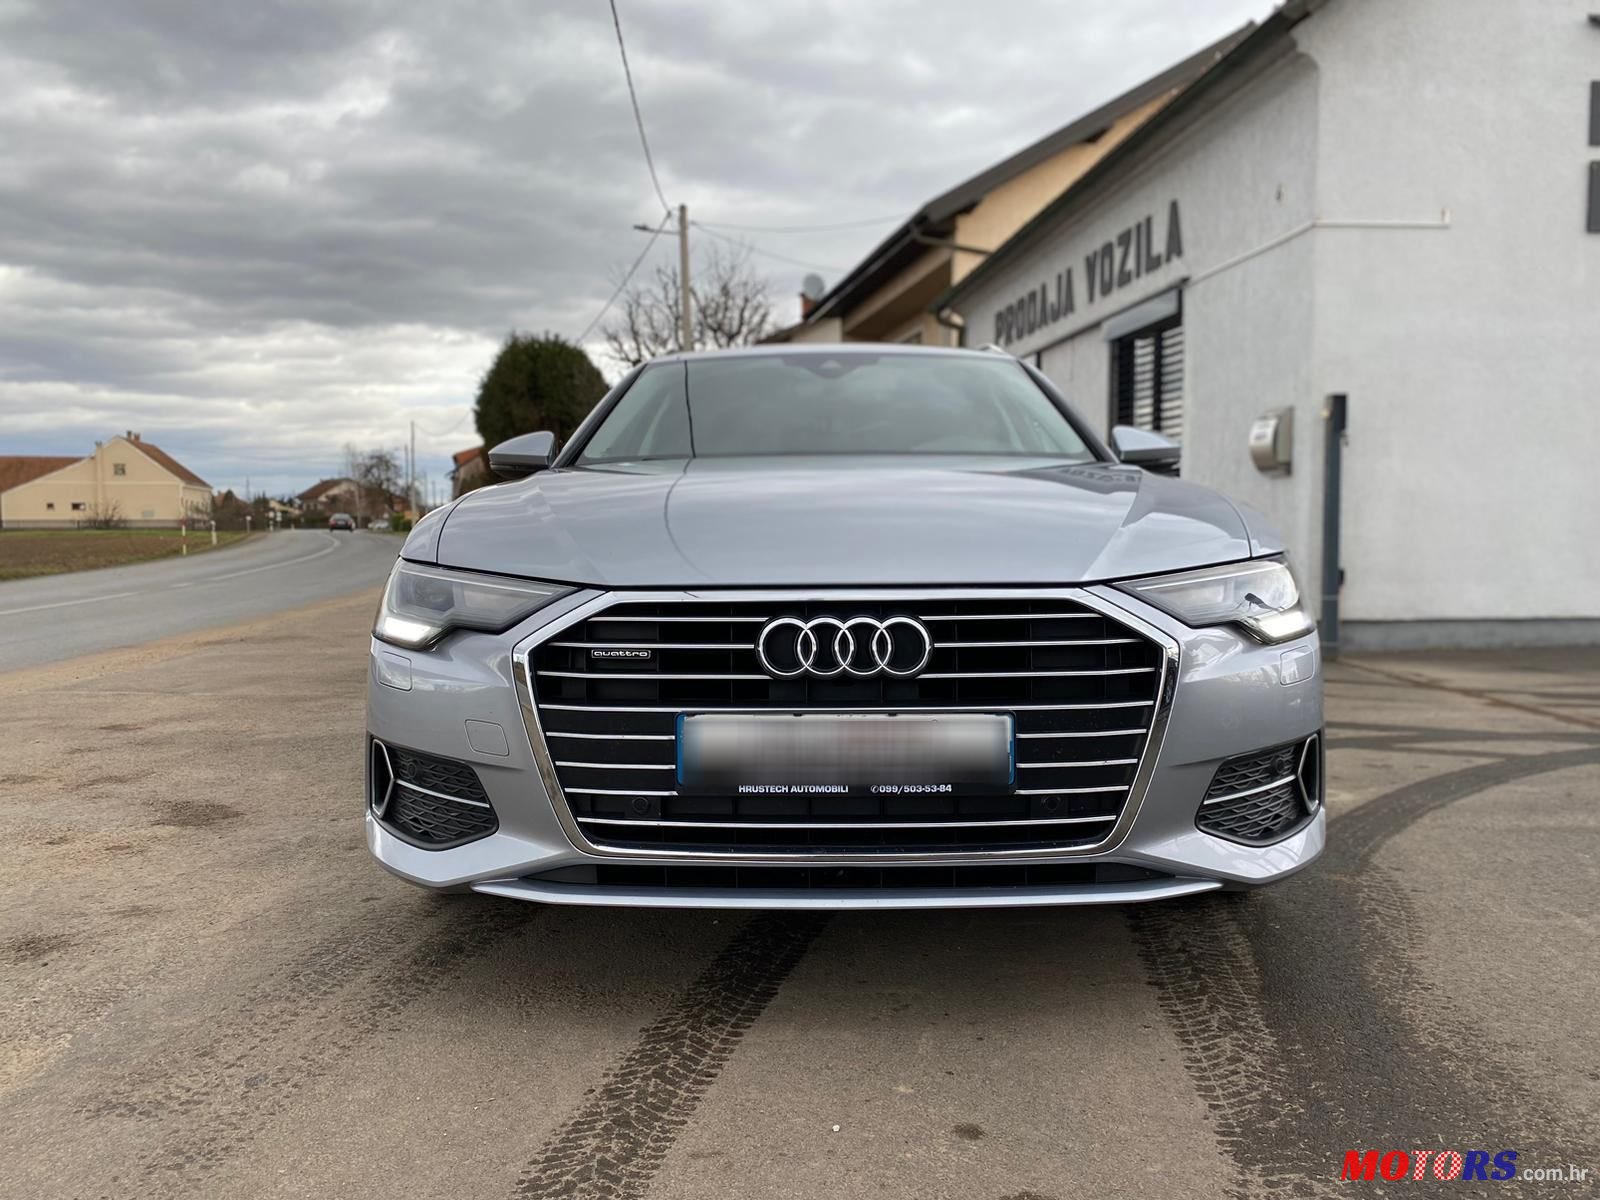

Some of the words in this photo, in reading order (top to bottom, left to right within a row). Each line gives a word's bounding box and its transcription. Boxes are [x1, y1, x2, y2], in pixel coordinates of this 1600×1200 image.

[994, 268, 1074, 345] PRODAJA
[1085, 199, 1183, 304] VOZILA
[738, 784, 789, 793] HRUSTECH
[790, 784, 849, 793] AUTOMOBILI
